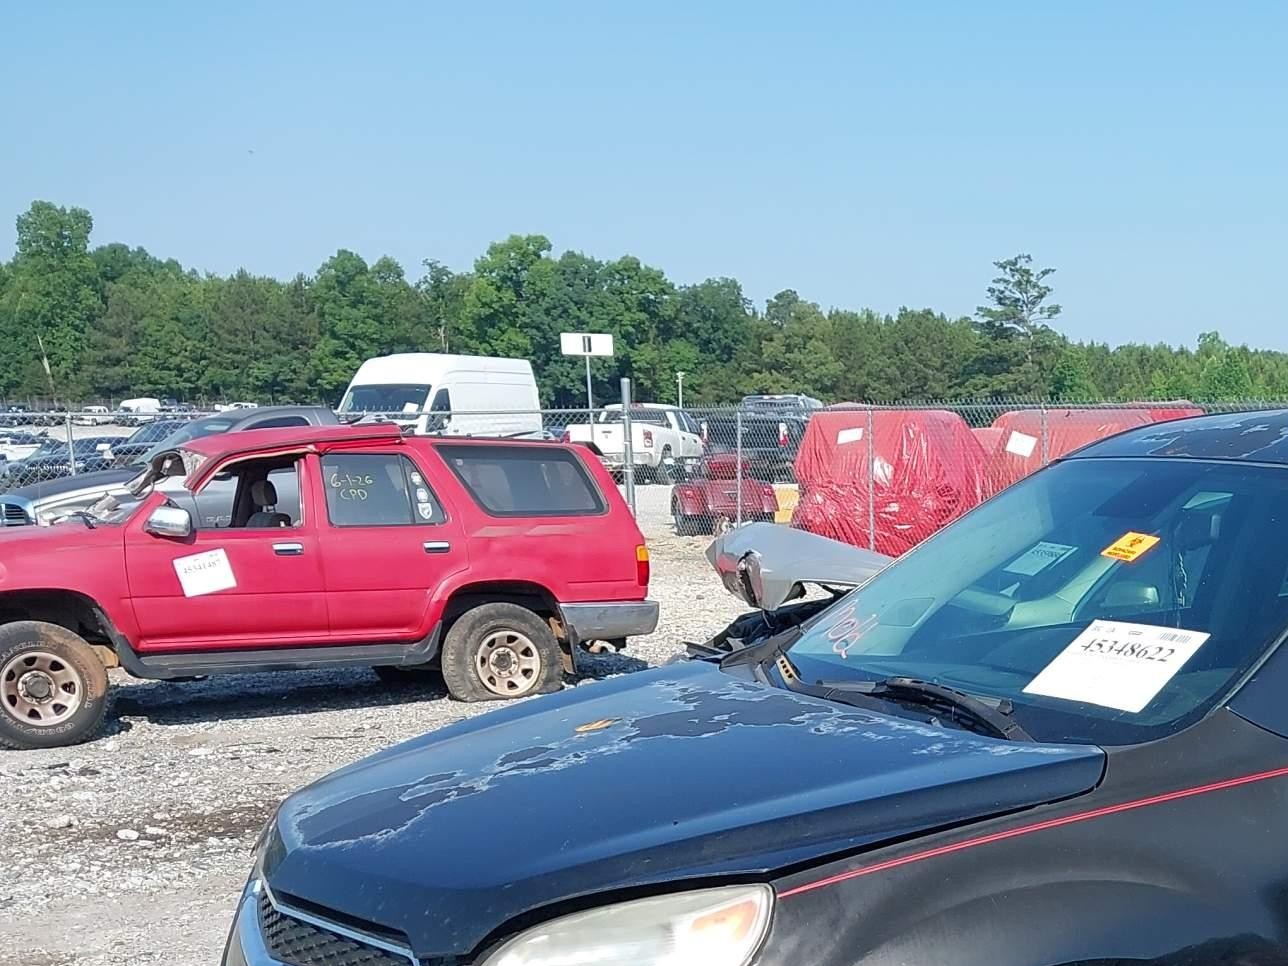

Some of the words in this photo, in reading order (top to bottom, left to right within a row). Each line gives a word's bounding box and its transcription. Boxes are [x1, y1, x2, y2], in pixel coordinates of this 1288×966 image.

[330, 473, 373, 487] 6-1-26
[340, 488, 368, 500] CPD
[1080, 637, 1176, 663] 45348622
